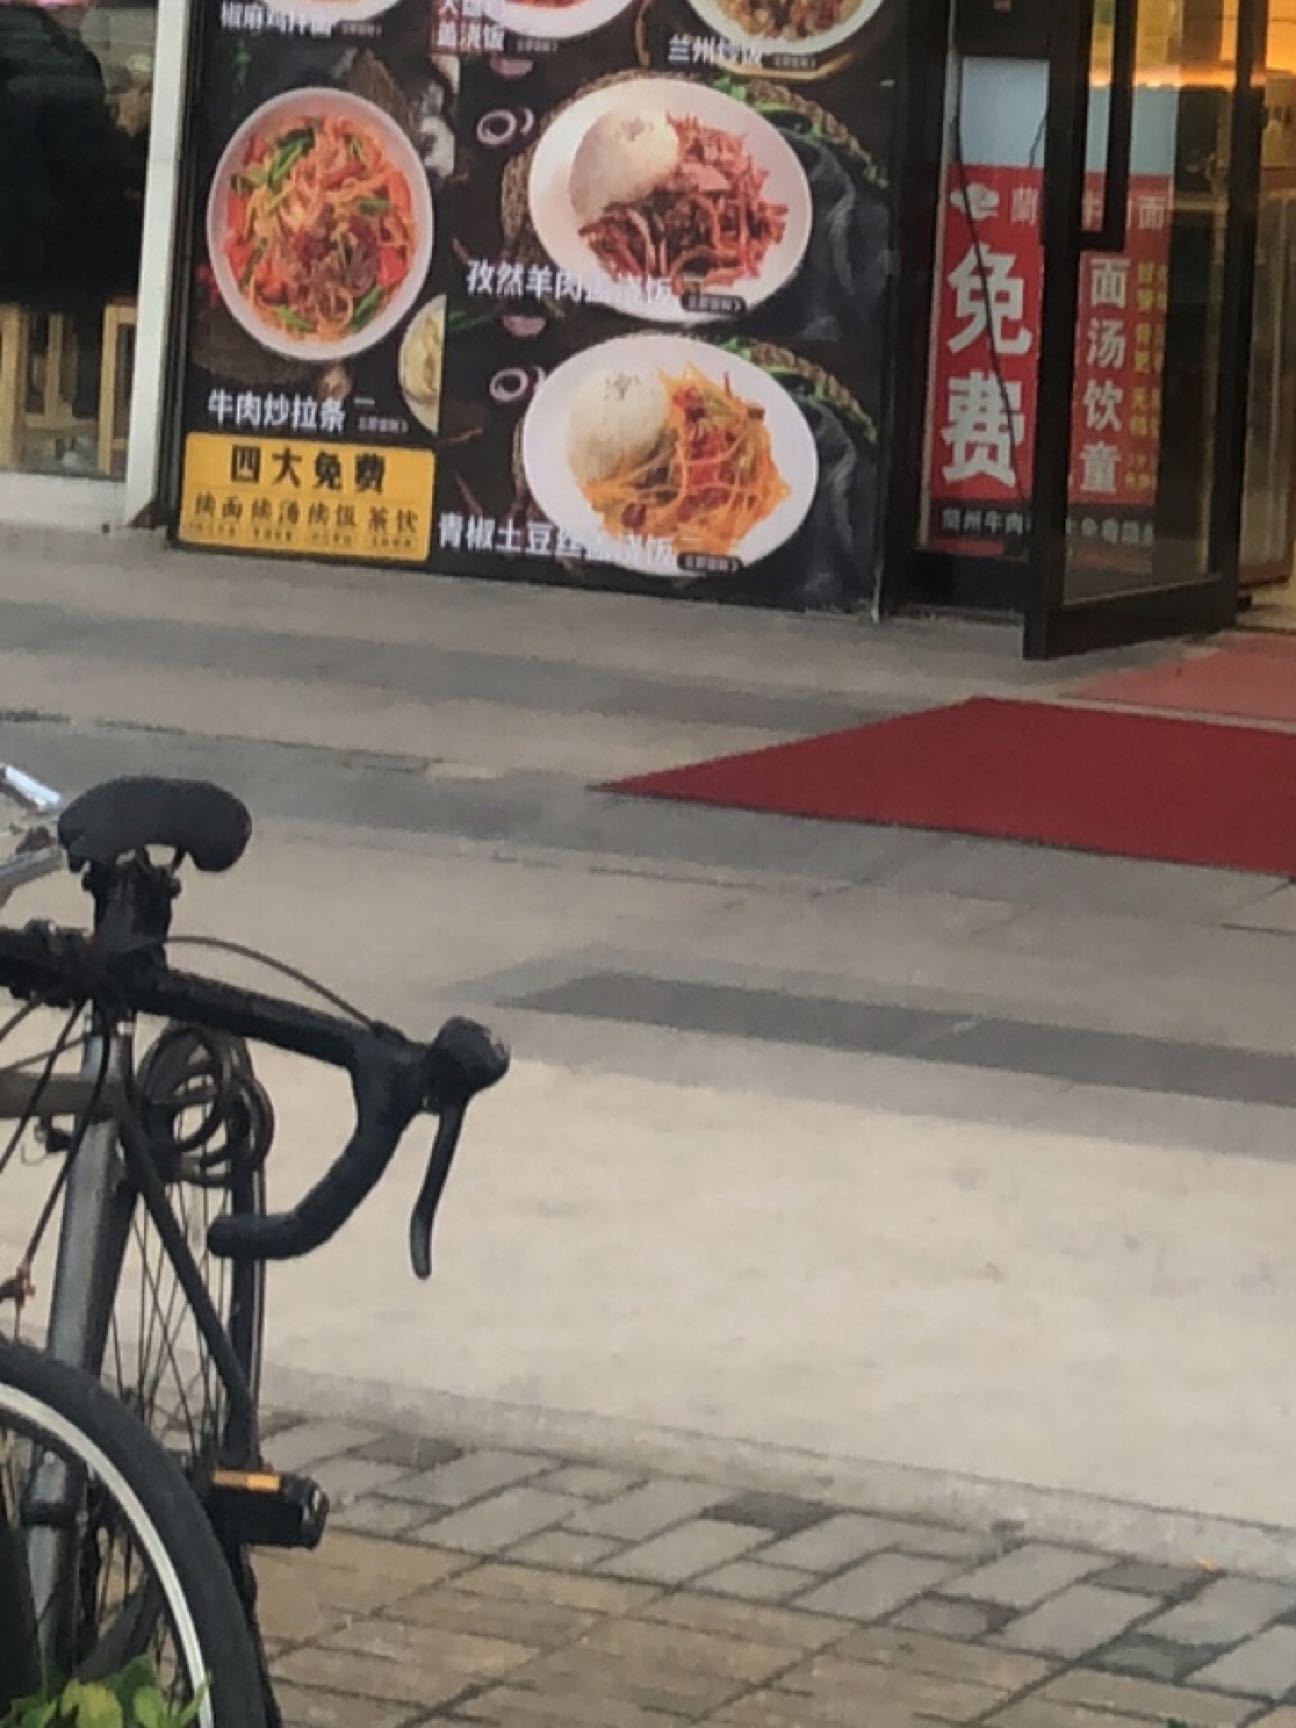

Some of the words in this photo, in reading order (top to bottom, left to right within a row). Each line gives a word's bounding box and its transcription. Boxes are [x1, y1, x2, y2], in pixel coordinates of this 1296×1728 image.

[940, 242, 1033, 489] 免费
[208, 387, 346, 433] 牛肉炒拉条
[231, 444, 386, 496] 四大免费
